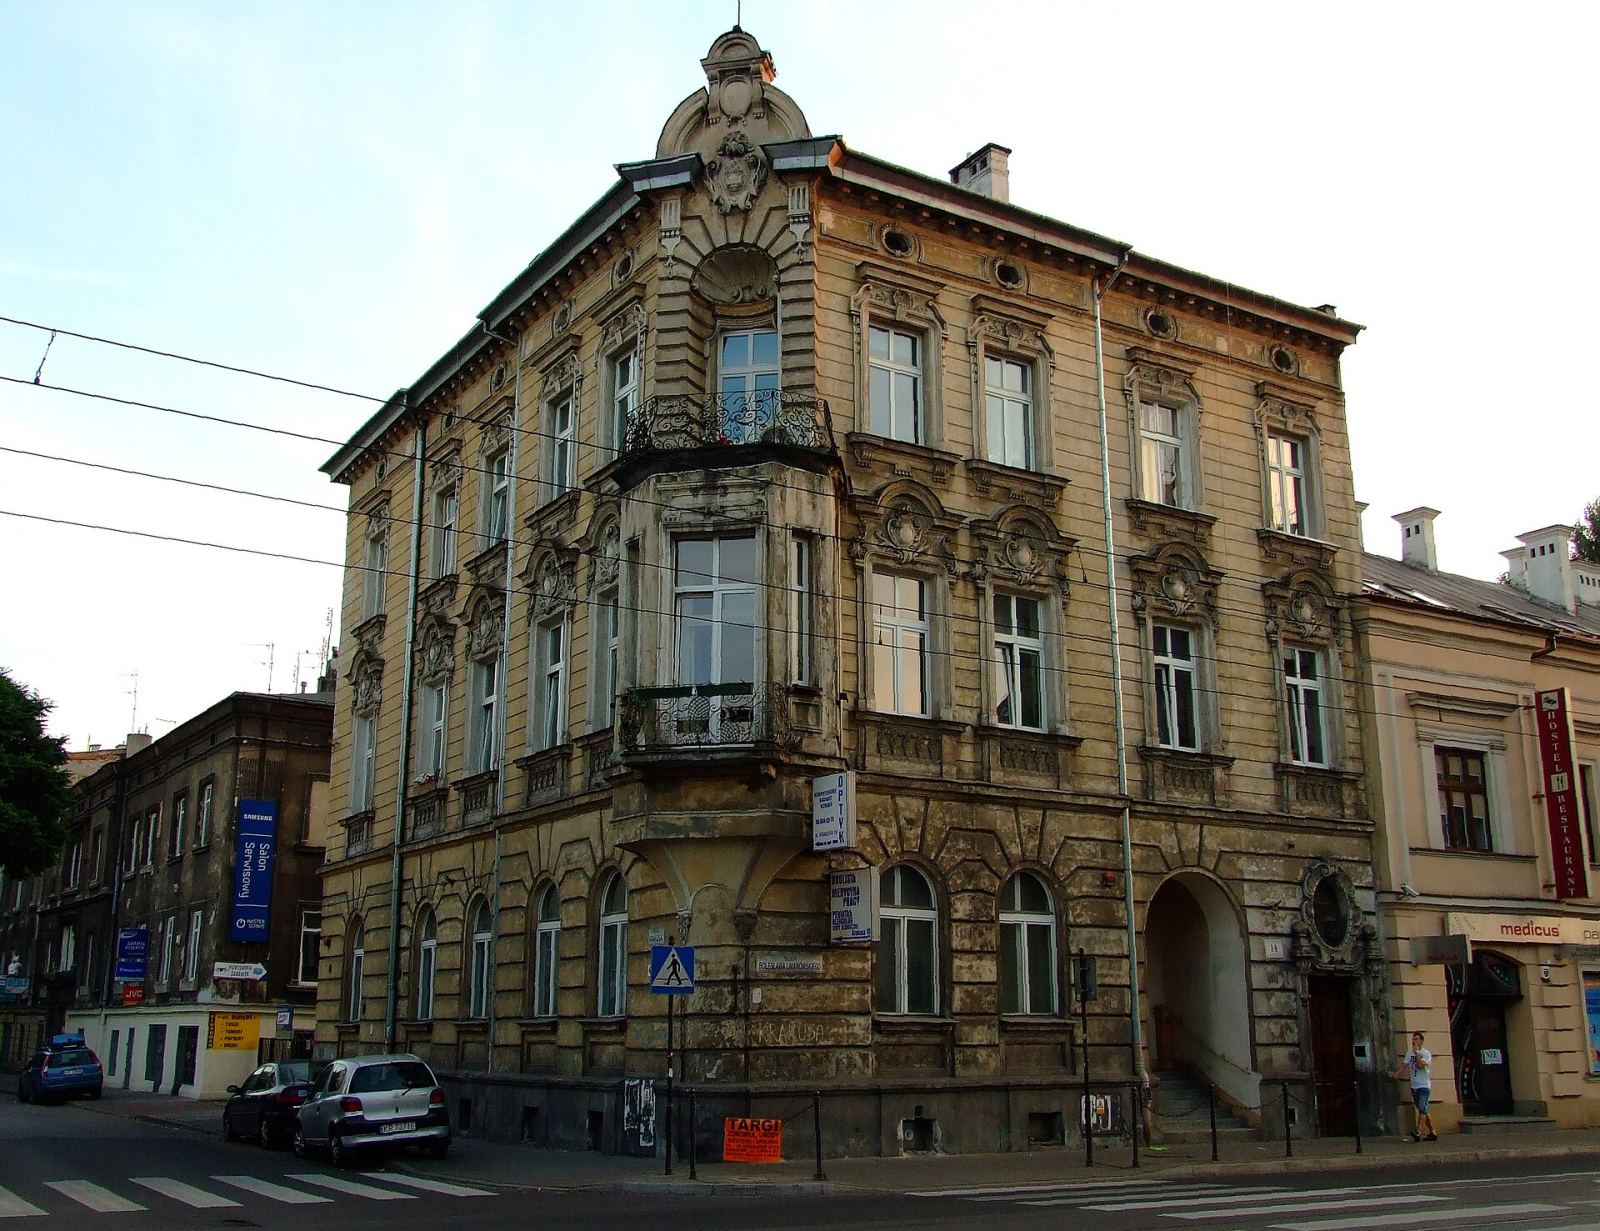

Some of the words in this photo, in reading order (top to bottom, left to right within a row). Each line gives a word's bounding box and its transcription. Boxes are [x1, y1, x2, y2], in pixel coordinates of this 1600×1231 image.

[1548, 711, 1562, 772] HOSTEL
[243, 813, 273, 823] SAMSUNG
[1558, 795, 1575, 896] RESTAURANT
[257, 843, 271, 872] Salon
[238, 842, 256, 898] Serwisowy
[831, 886, 860, 898] MEDYCYNA
[1500, 920, 1560, 937] medicus
[125, 989, 143, 998] JVC
[758, 1022, 825, 1044] KRAKUSA
[728, 1118, 779, 1131] TARGI
